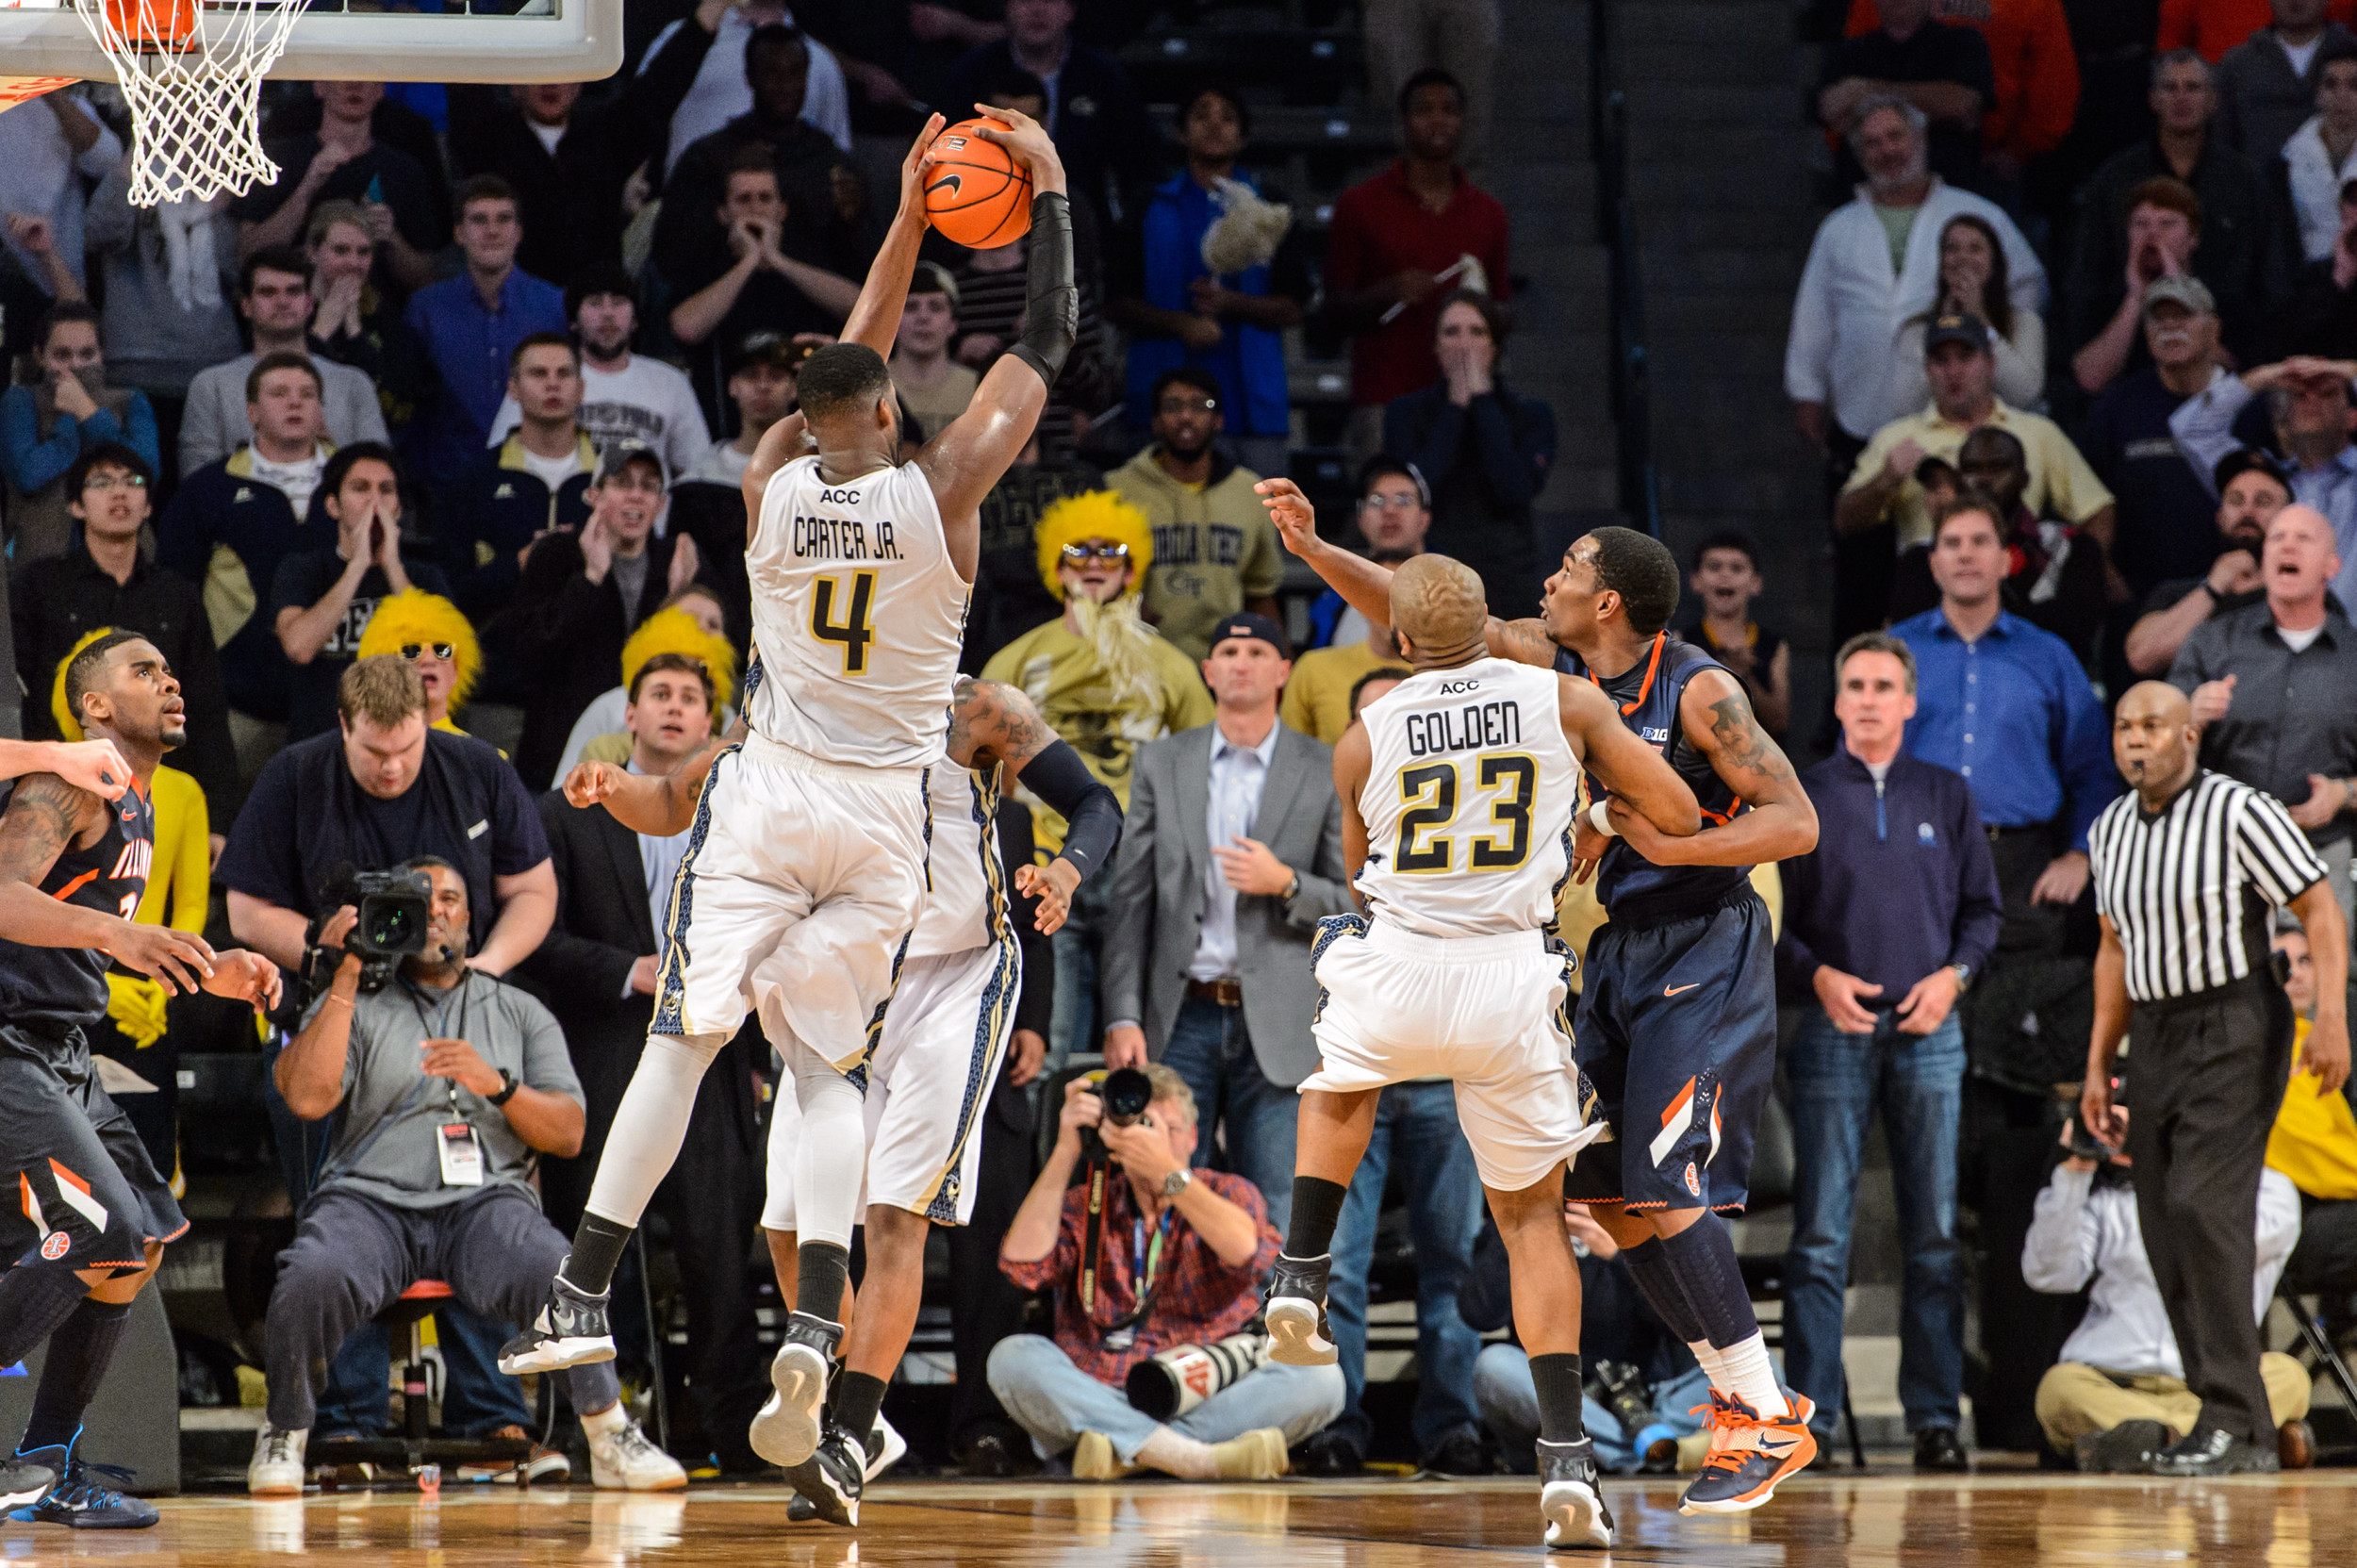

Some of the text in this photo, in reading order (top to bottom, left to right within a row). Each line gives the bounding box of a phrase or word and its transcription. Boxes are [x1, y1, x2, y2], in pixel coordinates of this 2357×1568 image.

[819, 488, 861, 505] ACC
[794, 516, 904, 560] CARTER JR.
[808, 568, 880, 677] 4
[1440, 680, 1480, 696] ACC
[1407, 700, 1521, 756] GOLDEN
[1393, 751, 1541, 875] 23
